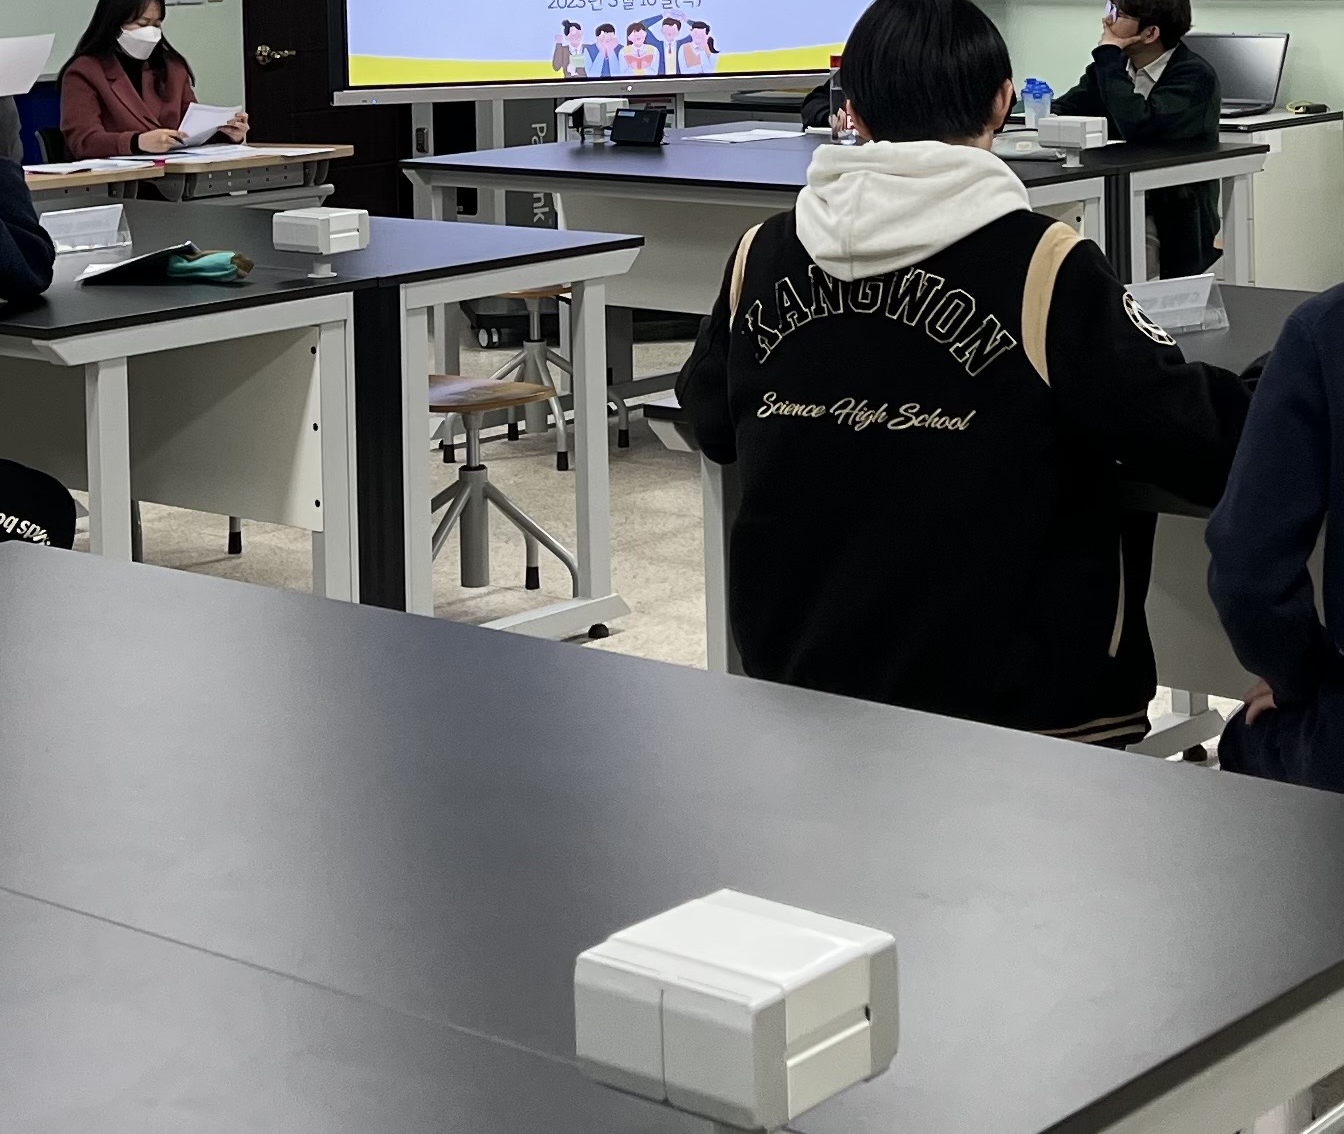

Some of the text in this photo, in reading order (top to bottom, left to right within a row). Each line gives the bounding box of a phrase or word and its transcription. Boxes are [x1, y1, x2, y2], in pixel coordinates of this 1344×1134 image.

[738, 264, 1017, 377] KANGWON
[757, 391, 977, 431] Science High School
